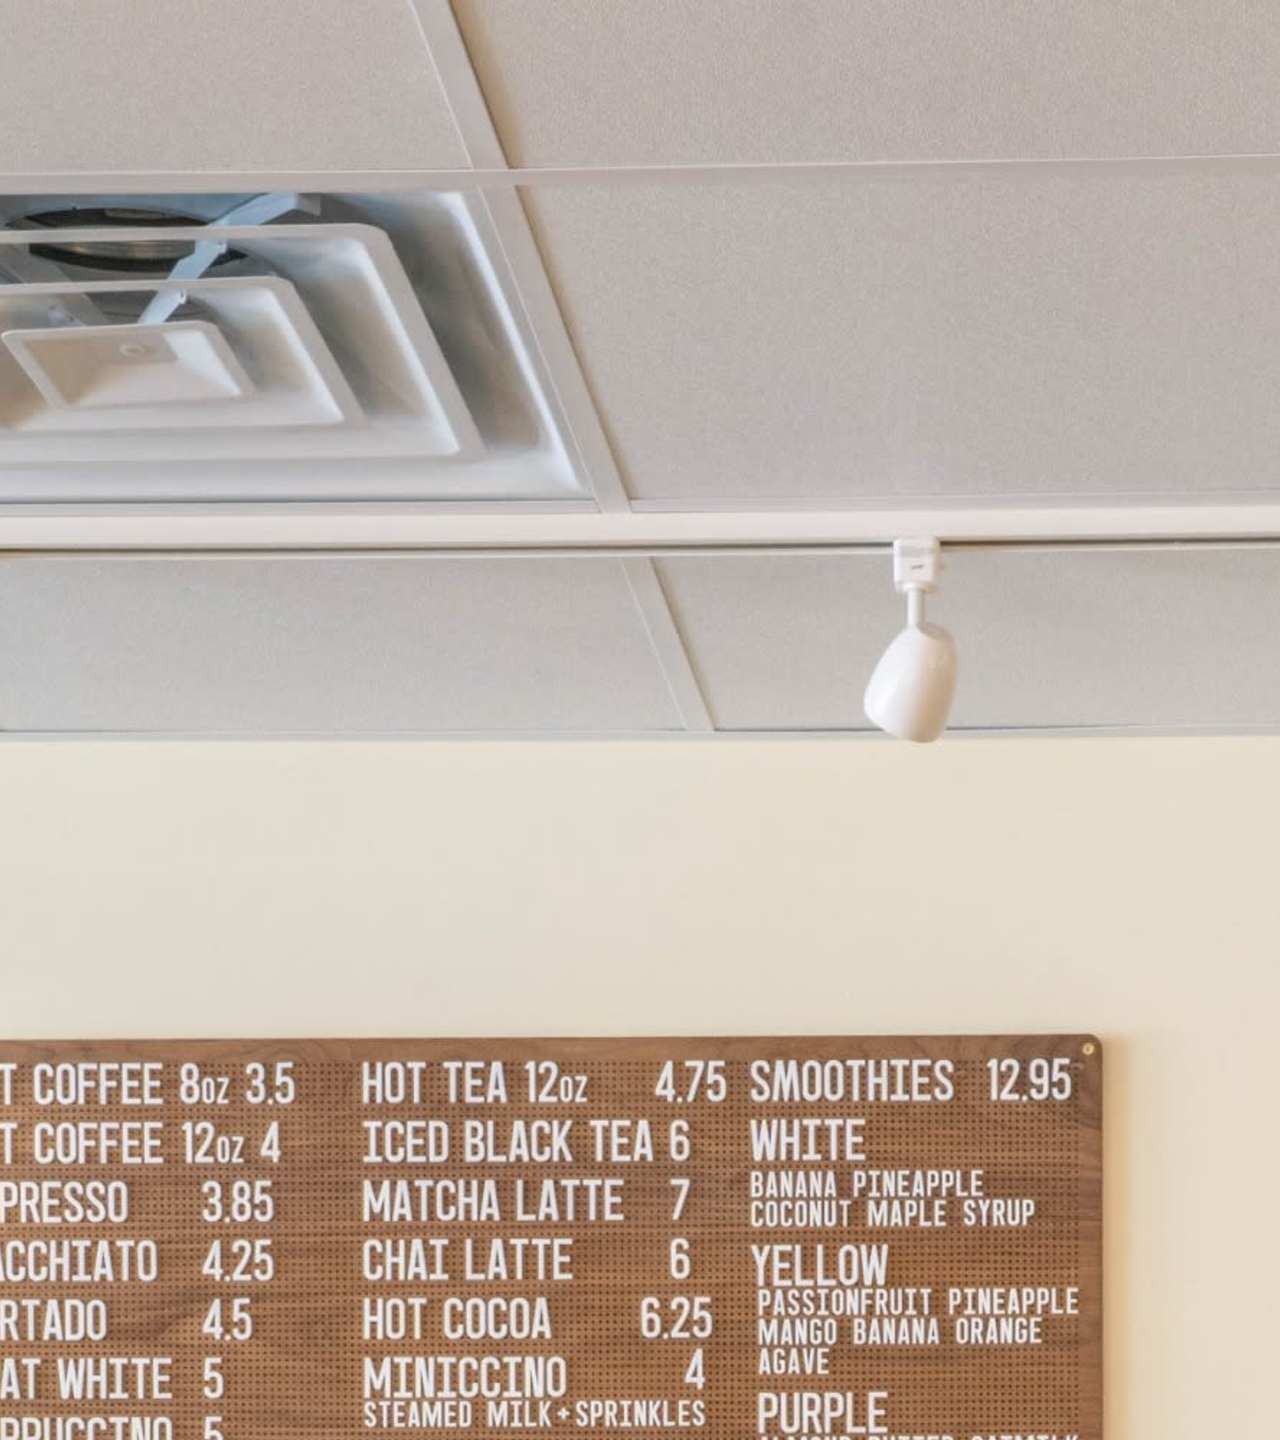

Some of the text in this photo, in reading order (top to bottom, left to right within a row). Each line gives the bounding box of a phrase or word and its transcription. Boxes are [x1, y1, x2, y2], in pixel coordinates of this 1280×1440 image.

[33, 1062, 164, 1106] COFFEE
[245, 1061, 295, 1105] 3.5
[750, 1057, 1071, 1103] SMOOTHIES 12.95
[201, 1179, 274, 1223] 3.85
[362, 1178, 690, 1222] MATCHA LATTE 7
[750, 1169, 984, 1198] BANANA PINEAPPLE
[750, 1199, 1035, 1228] COCONUT MAPLE SYRUP
[201, 1238, 274, 1282] 4.25
[201, 1297, 252, 1341] 4.5
[757, 1287, 1079, 1317] PASSIONFRUIT PINEAPPLE
